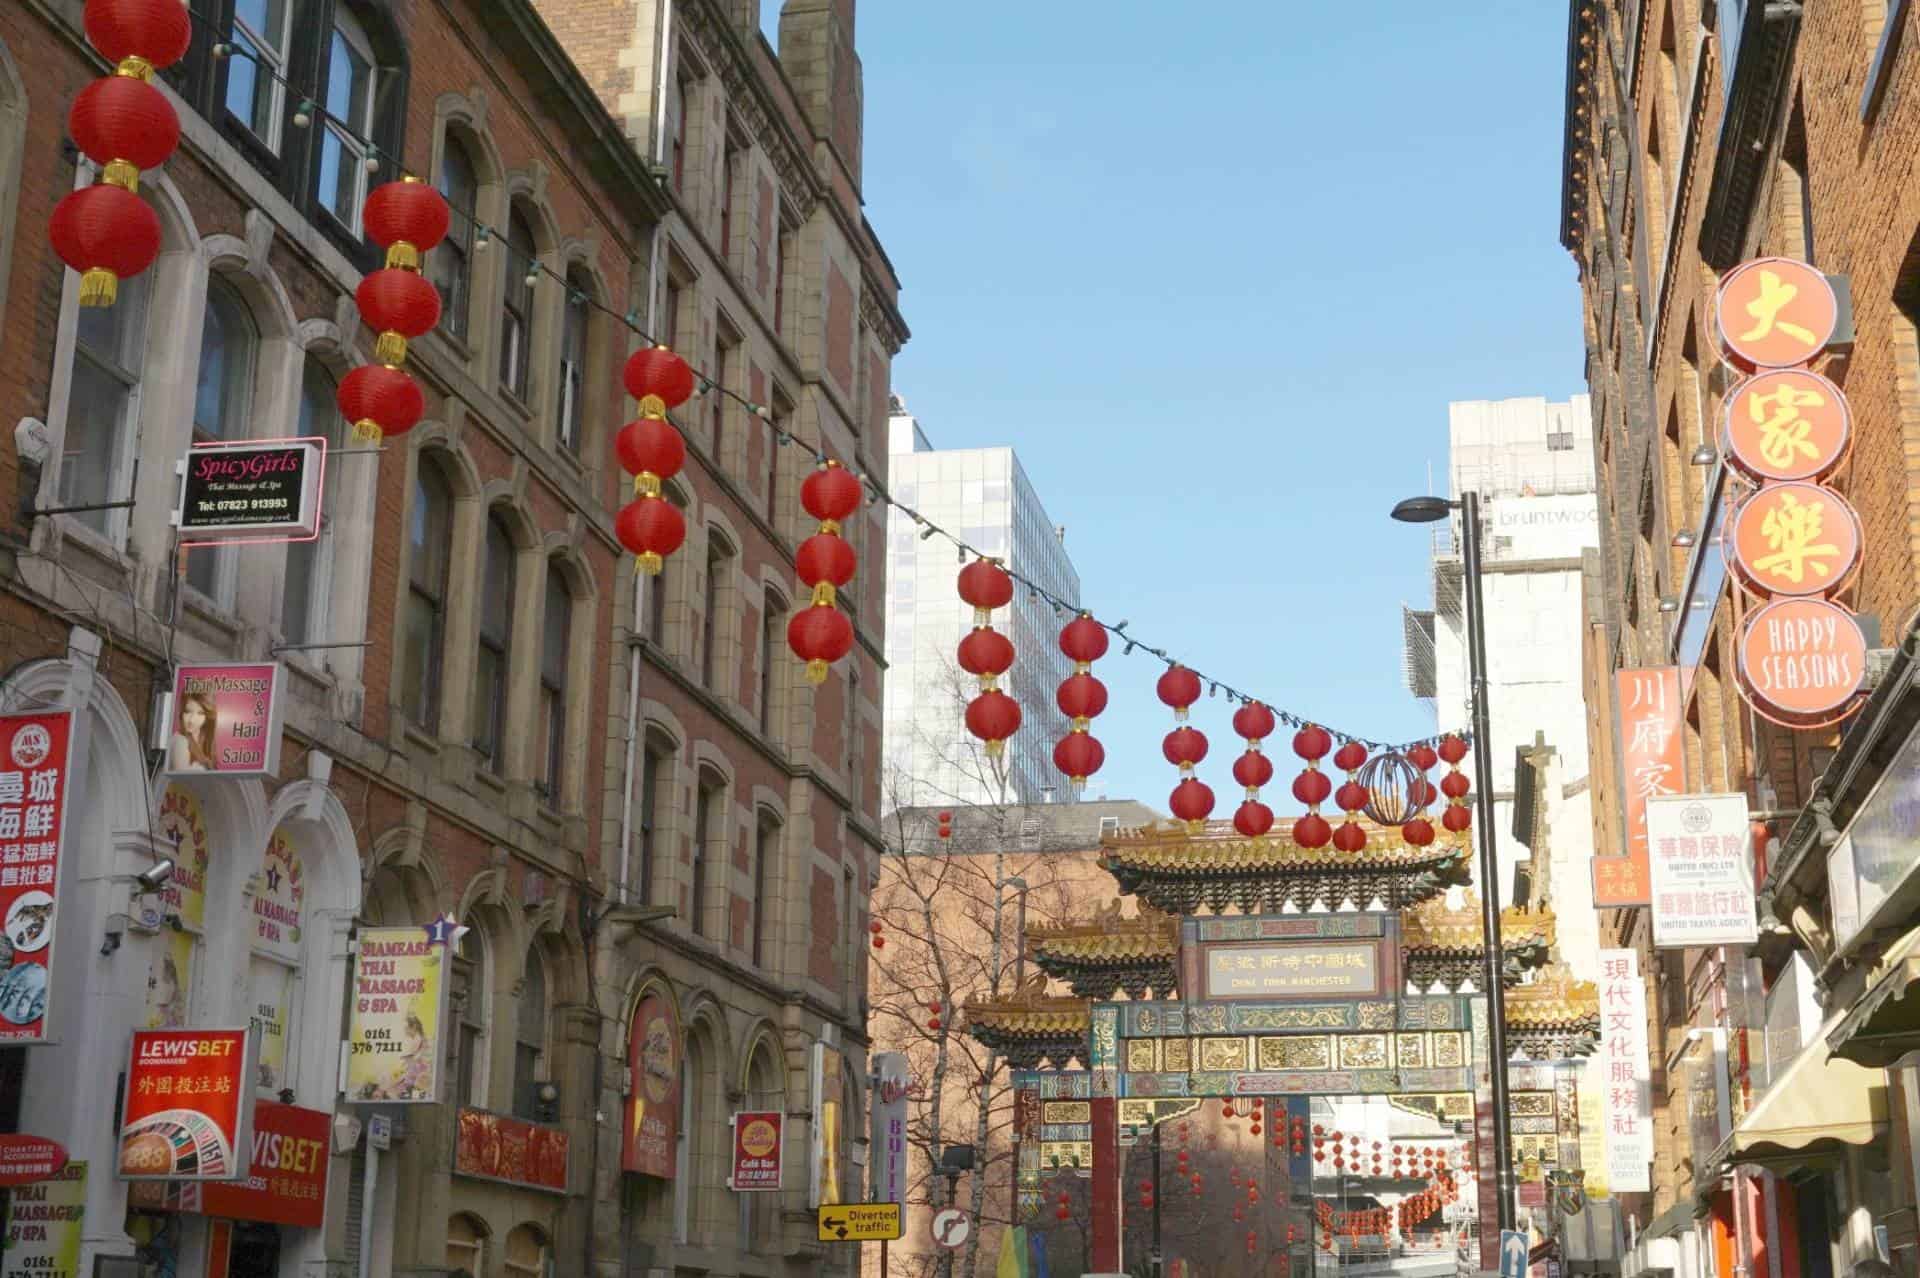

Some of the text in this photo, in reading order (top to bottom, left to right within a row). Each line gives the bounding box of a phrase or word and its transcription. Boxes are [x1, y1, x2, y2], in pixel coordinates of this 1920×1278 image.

[1741, 268, 1841, 583] 大家樂
[197, 498, 288, 512] Tel: 07823 913993
[1767, 617, 1838, 652] HAPPY
[1761, 654, 1852, 690] SEASONS
[184, 676, 269, 697] Thai Massage
[254, 700, 264, 716] &
[232, 721, 263, 738] Hair
[222, 748, 261, 764] Salon
[1629, 671, 1680, 843] 川府家
[433, 921, 444, 941] 1
[360, 941, 434, 957] SIAMEASE
[360, 960, 396, 976] THAI
[357, 978, 426, 994] MASSAGE
[1291, 975, 1351, 986] MANCHESTER
[357, 998, 399, 1013] & SPA
[364, 1028, 392, 1040] 0161
[140, 1039, 235, 1057] LEWISBET
[351, 1042, 403, 1055] 376 7211
[1603, 958, 1640, 1136] 現代文化服務社
[138, 1057, 188, 1065] BOOKMAKERS
[15, 1185, 48, 1200] THAI
[13, 1205, 74, 1221] MASSAGE
[849, 1210, 898, 1221] Diverted
[22, 1225, 47, 1241] SPA
[855, 1220, 892, 1233] traffic
[23, 1256, 55, 1269] 0161
